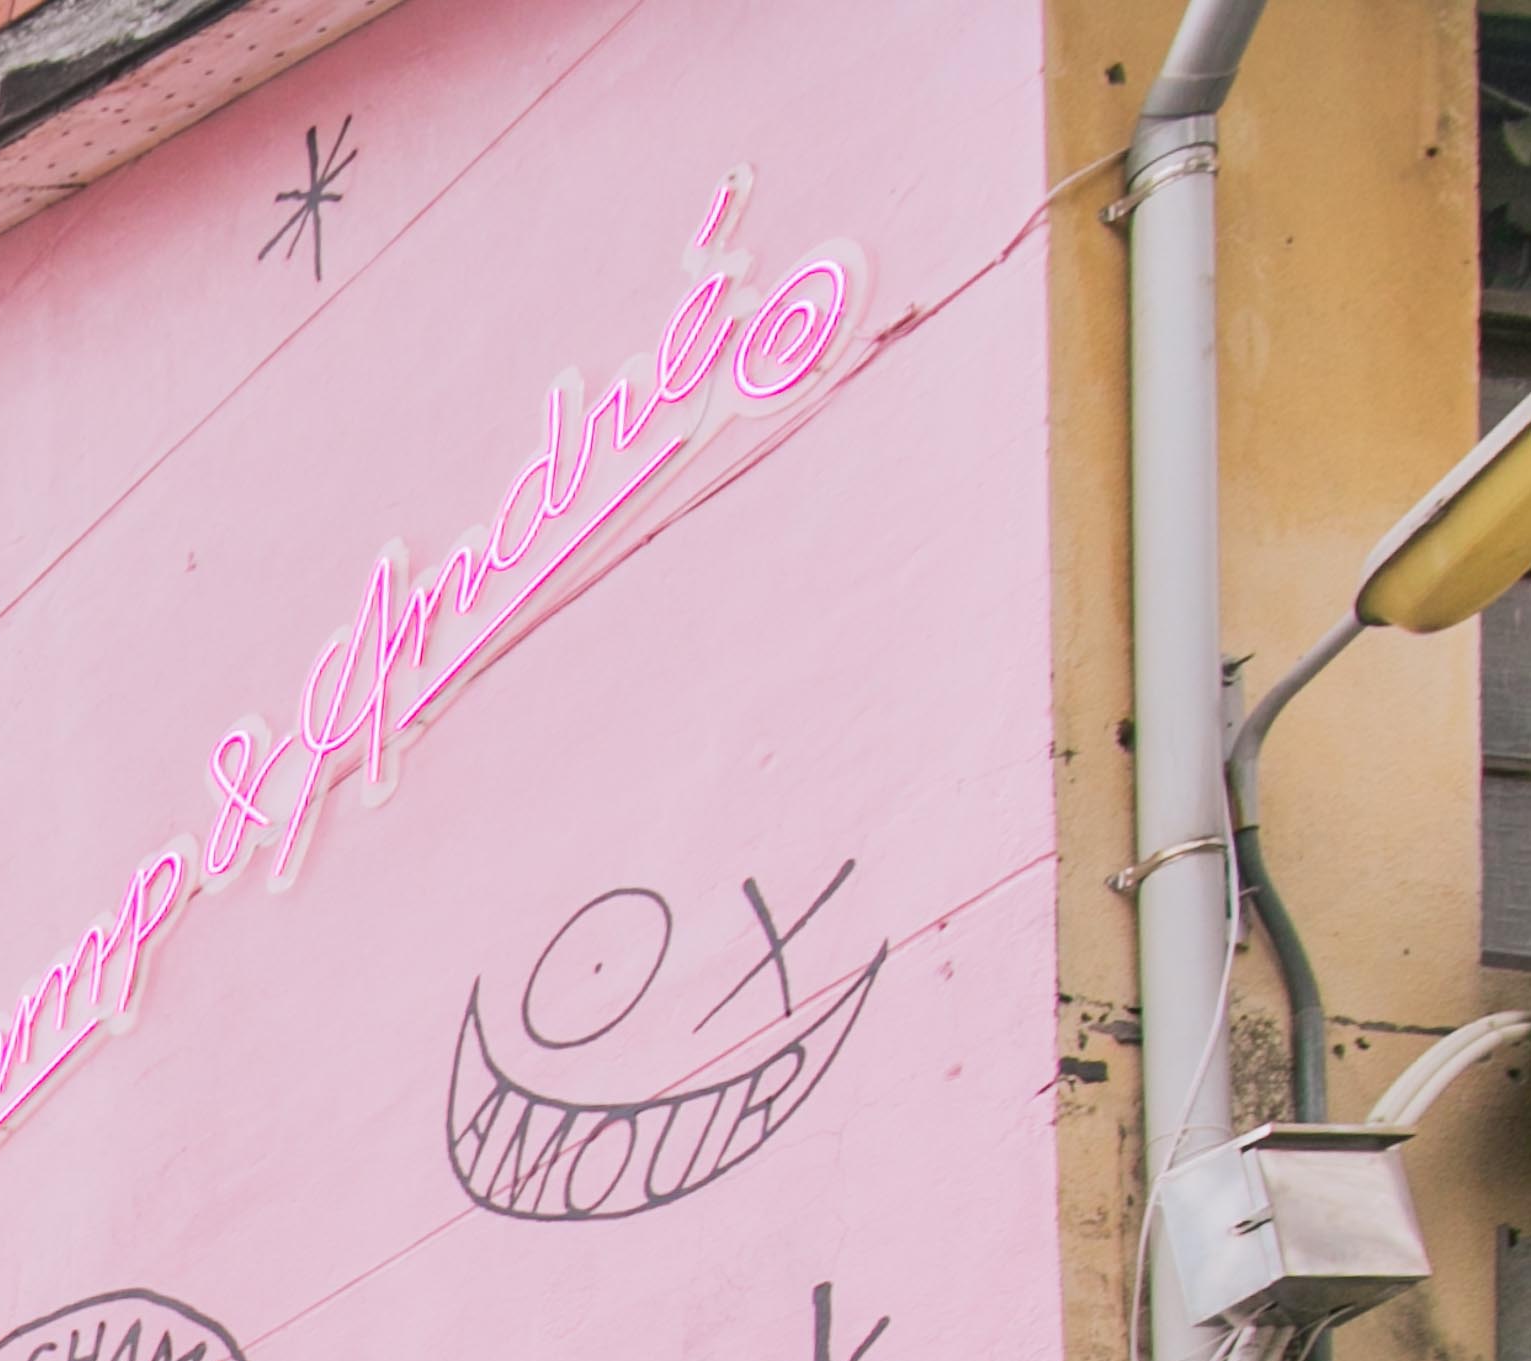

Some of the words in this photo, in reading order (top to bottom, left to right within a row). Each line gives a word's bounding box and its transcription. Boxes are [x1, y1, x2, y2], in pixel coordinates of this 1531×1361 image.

[208, 728, 293, 876] &
[274, 185, 736, 876] André
[452, 1040, 806, 1217] AMOUR
